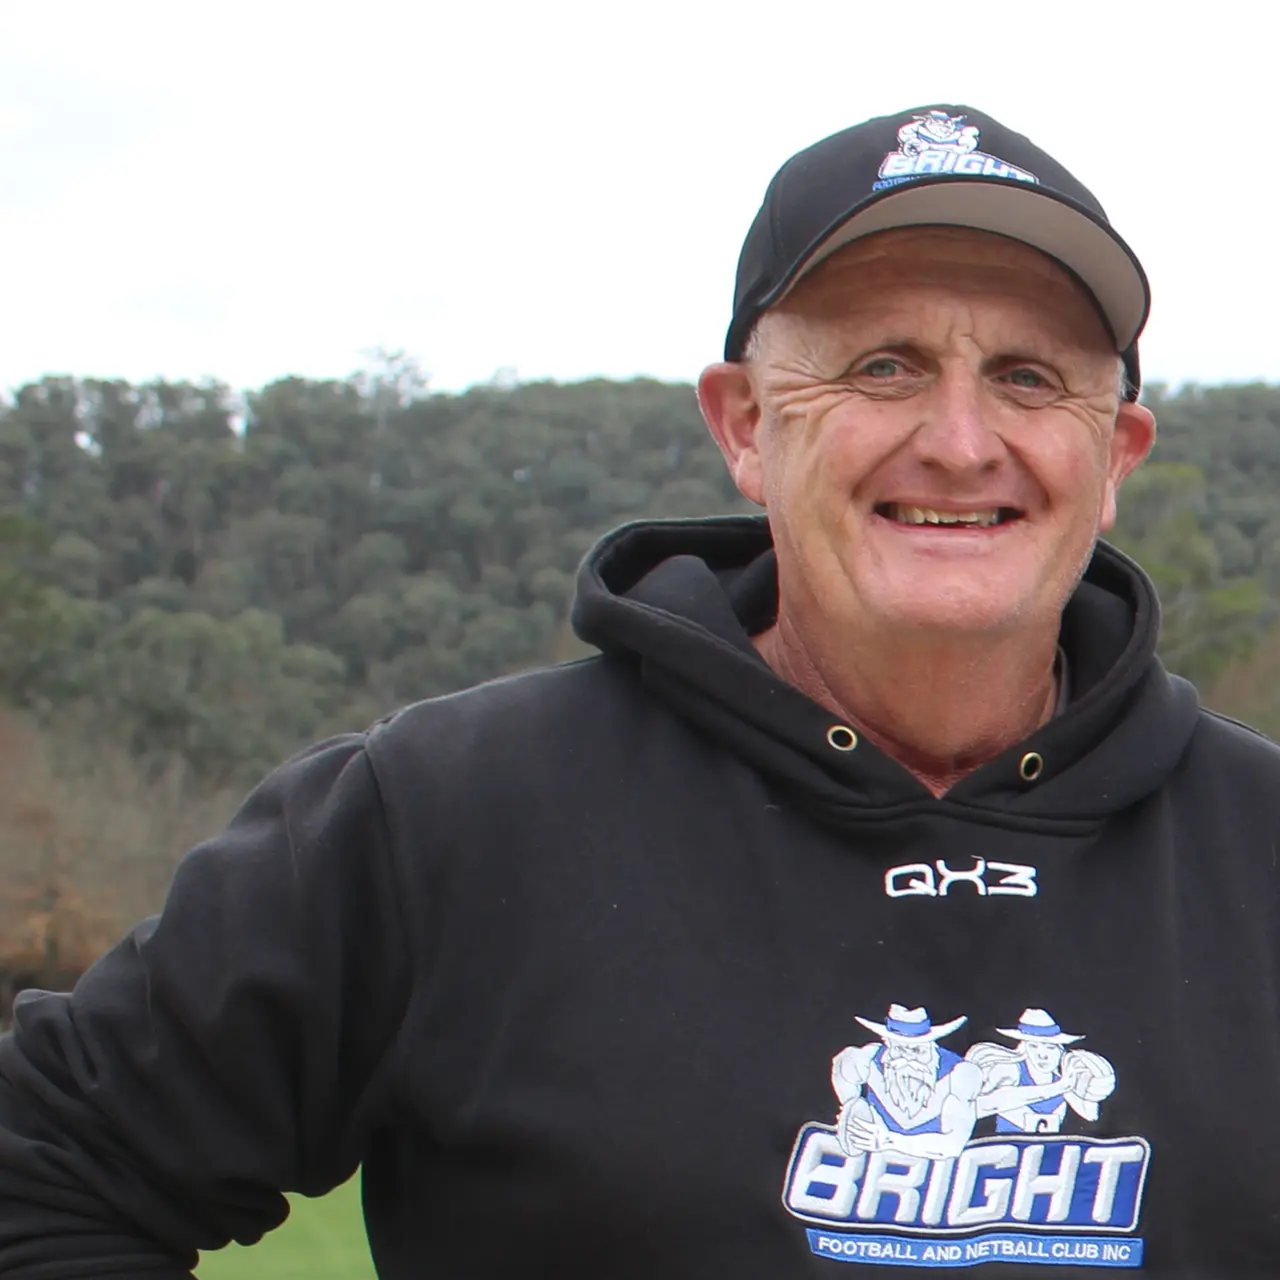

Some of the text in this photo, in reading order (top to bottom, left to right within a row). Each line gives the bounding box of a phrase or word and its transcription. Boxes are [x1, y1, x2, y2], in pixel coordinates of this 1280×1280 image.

[789, 1132, 1145, 1225] BRIGHT
[818, 1237, 1131, 1261] FOOTBALL AND NETBALL CLUB INC
